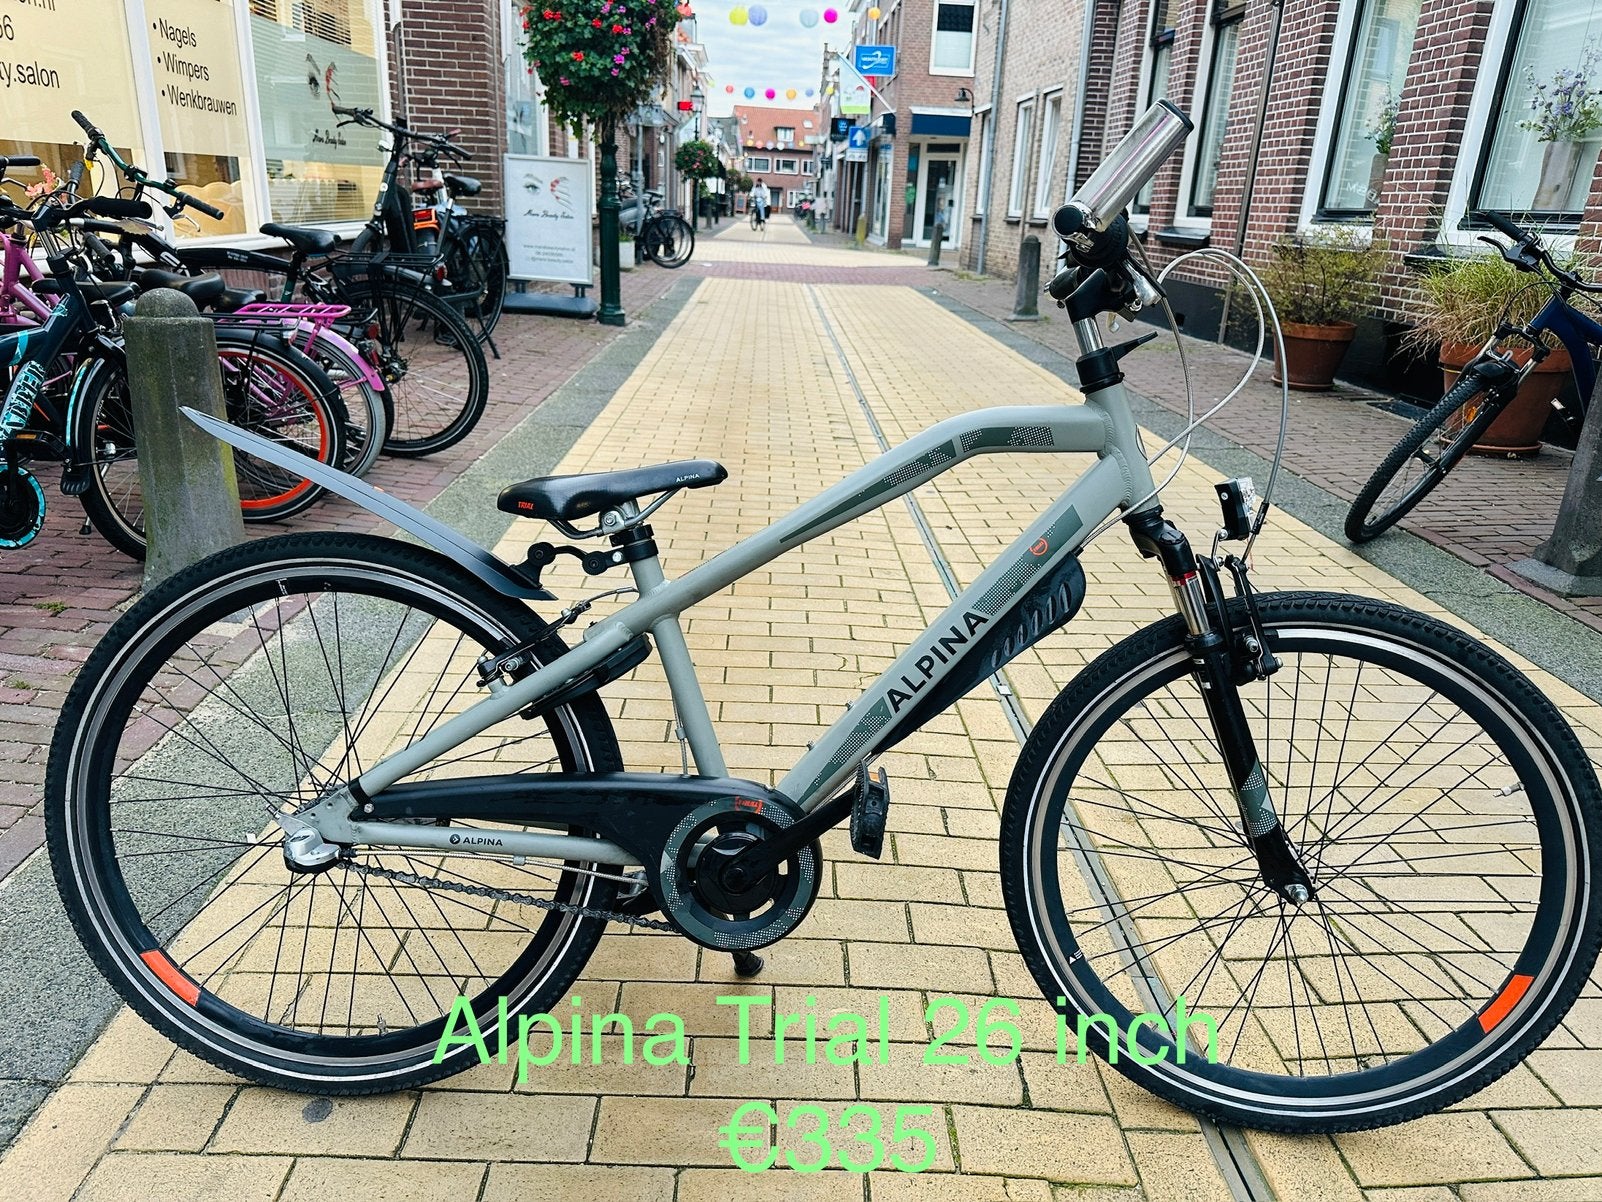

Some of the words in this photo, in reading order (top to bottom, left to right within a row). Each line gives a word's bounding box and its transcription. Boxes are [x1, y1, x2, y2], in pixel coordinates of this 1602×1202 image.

[158, 17, 197, 49] Nagels
[162, 51, 210, 82] Wimpers
[166, 84, 238, 116] Wenkbrauwen
[676, 473, 700, 483] ALPINA
[518, 501, 534, 510] TRIAL
[886, 611, 989, 714] ALPINA
[463, 836, 503, 846] ALPINA
